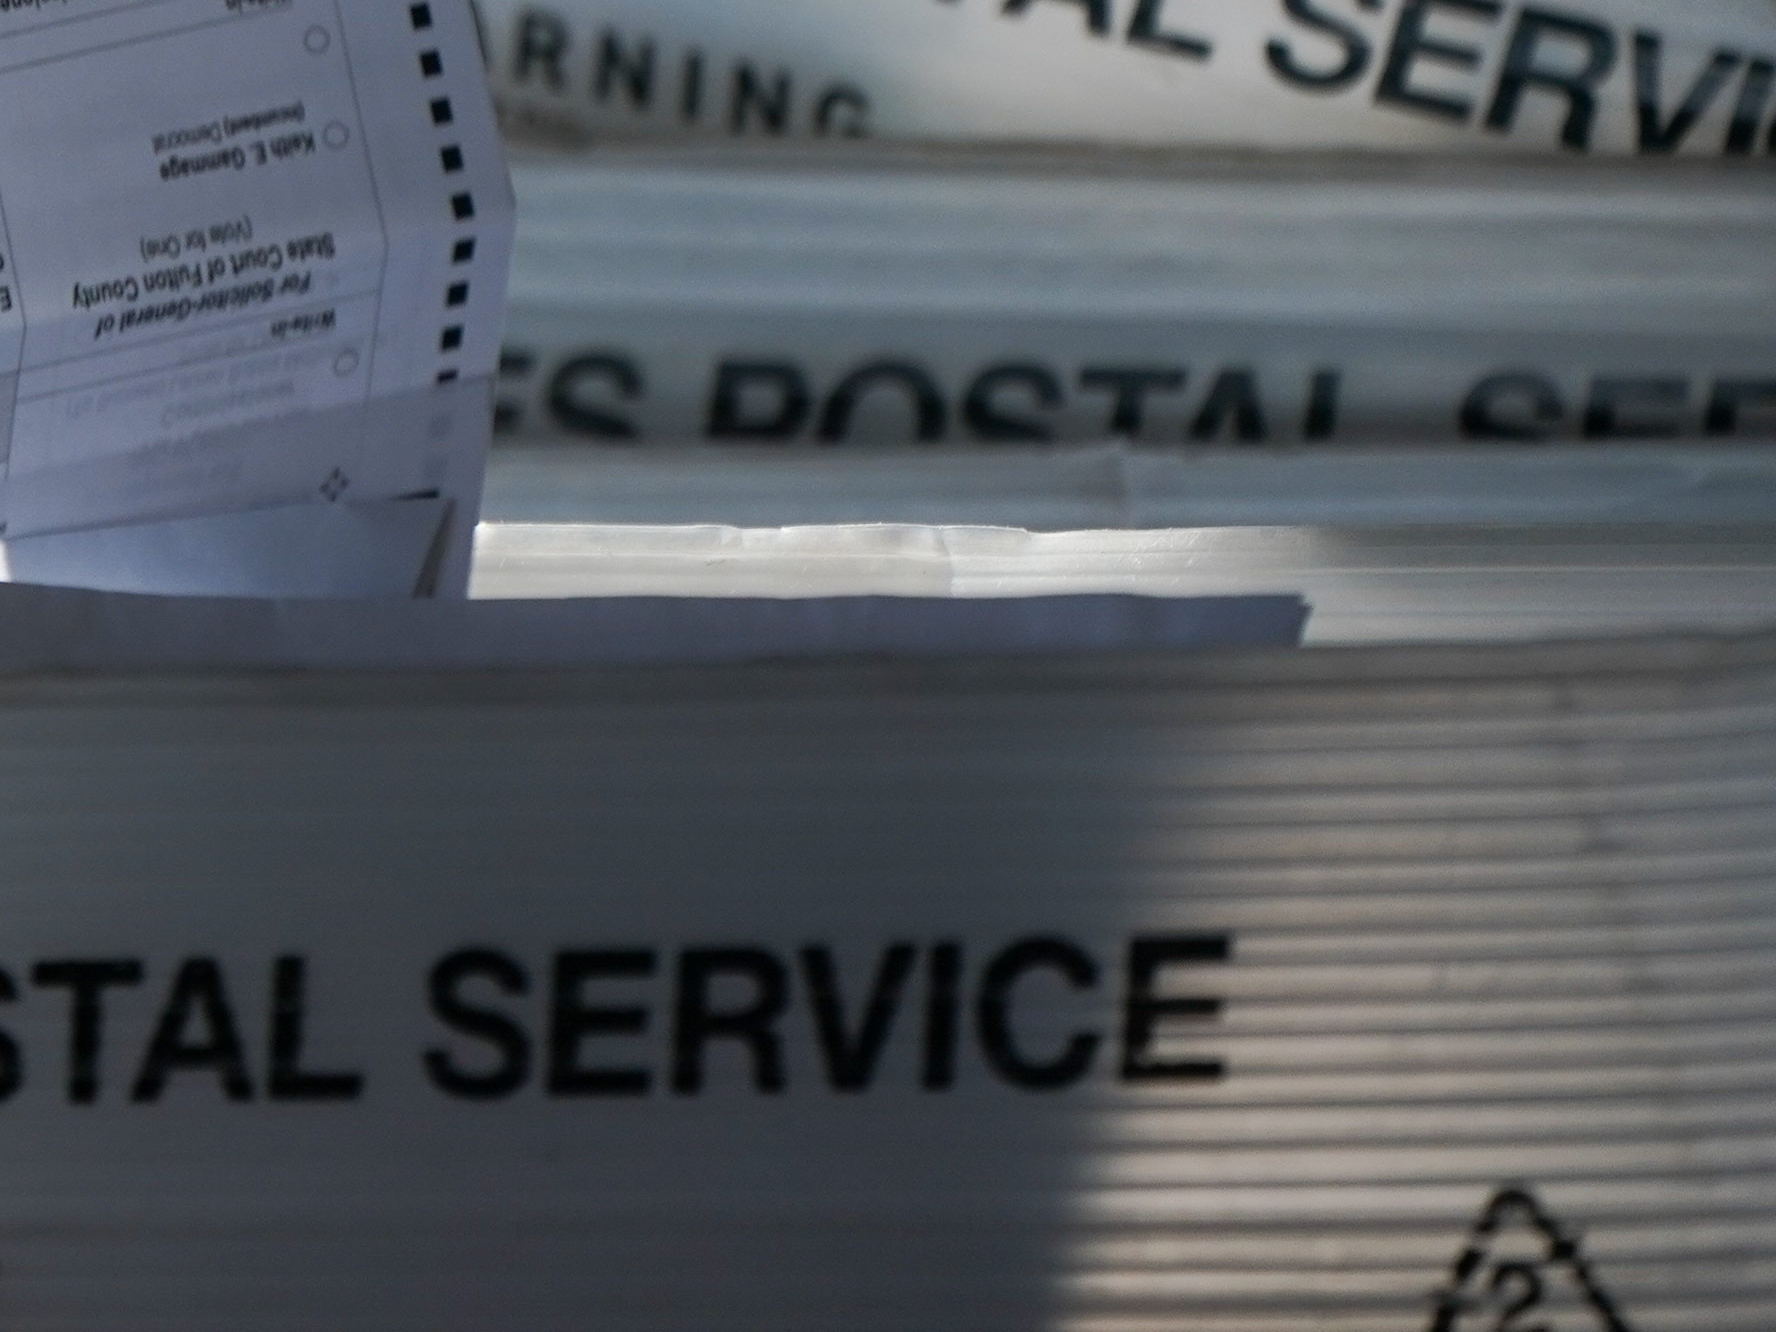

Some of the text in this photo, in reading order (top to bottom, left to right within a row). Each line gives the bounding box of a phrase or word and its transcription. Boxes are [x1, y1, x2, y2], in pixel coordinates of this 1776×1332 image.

[72, 231, 336, 310] State Court of Fulton County
[94, 313, 116, 340] of
[419, 934, 1236, 1102] SERVICE
